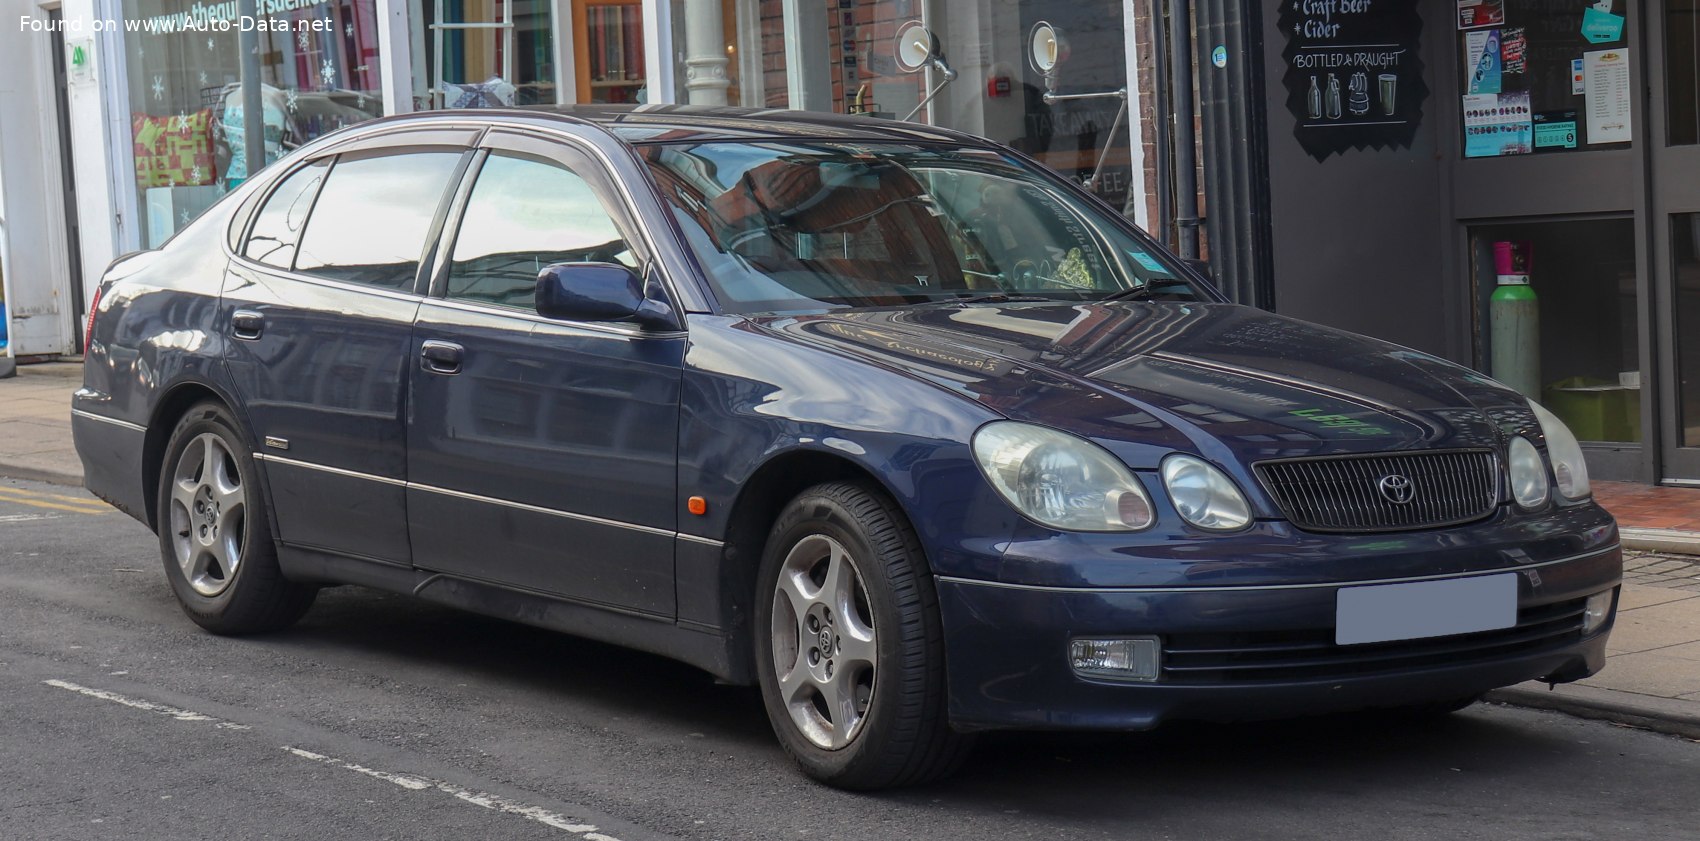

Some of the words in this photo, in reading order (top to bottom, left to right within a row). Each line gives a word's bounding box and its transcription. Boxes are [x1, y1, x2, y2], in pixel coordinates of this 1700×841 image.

[1302, 0, 1337, 22] Craft
[1339, 0, 1371, 14] Beer
[1304, 19, 1341, 38] Cider
[1293, 53, 1343, 68] BOTTLED
[1342, 55, 1352, 66] &
[1353, 49, 1407, 71] DRAUGHT
